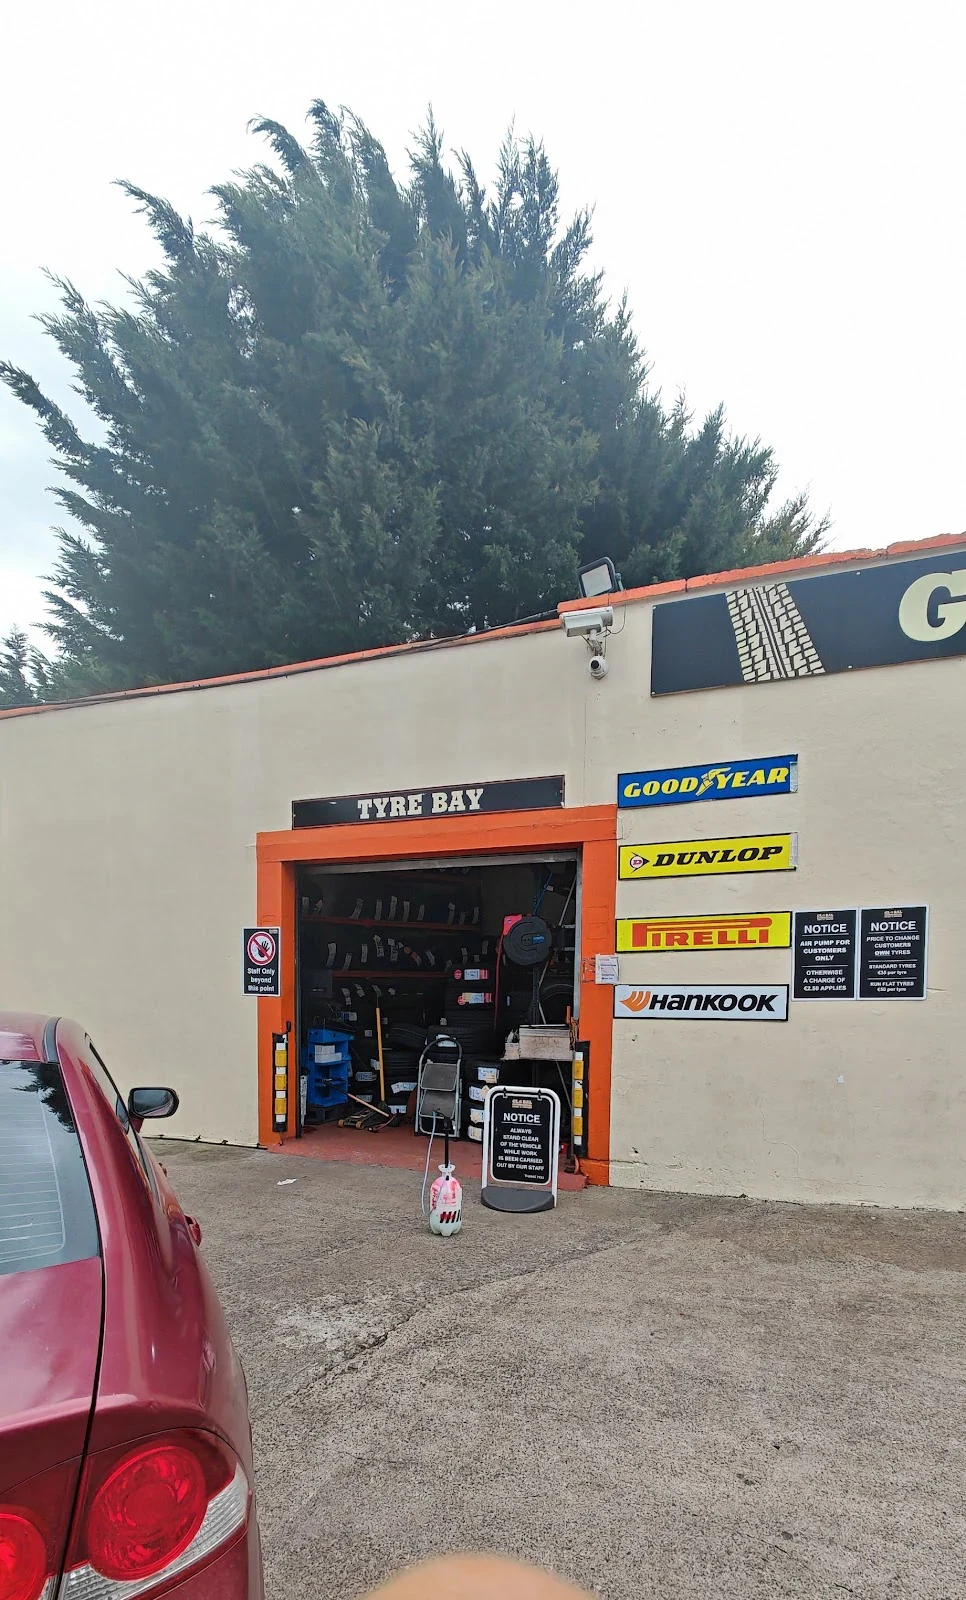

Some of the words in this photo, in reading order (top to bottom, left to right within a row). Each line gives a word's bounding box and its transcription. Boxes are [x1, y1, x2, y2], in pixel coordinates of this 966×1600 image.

[357, 793, 423, 819] TYRE
[431, 788, 484, 814] BAY
[653, 846, 783, 867] DUNLOP
[804, 923, 847, 934] NOTICE
[870, 921, 916, 931] NOTICE
[632, 917, 772, 947] PIRELLI
[261, 968, 275, 976] Only
[250, 976, 272, 984] beyond
[503, 1112, 541, 1123] NOTICE
